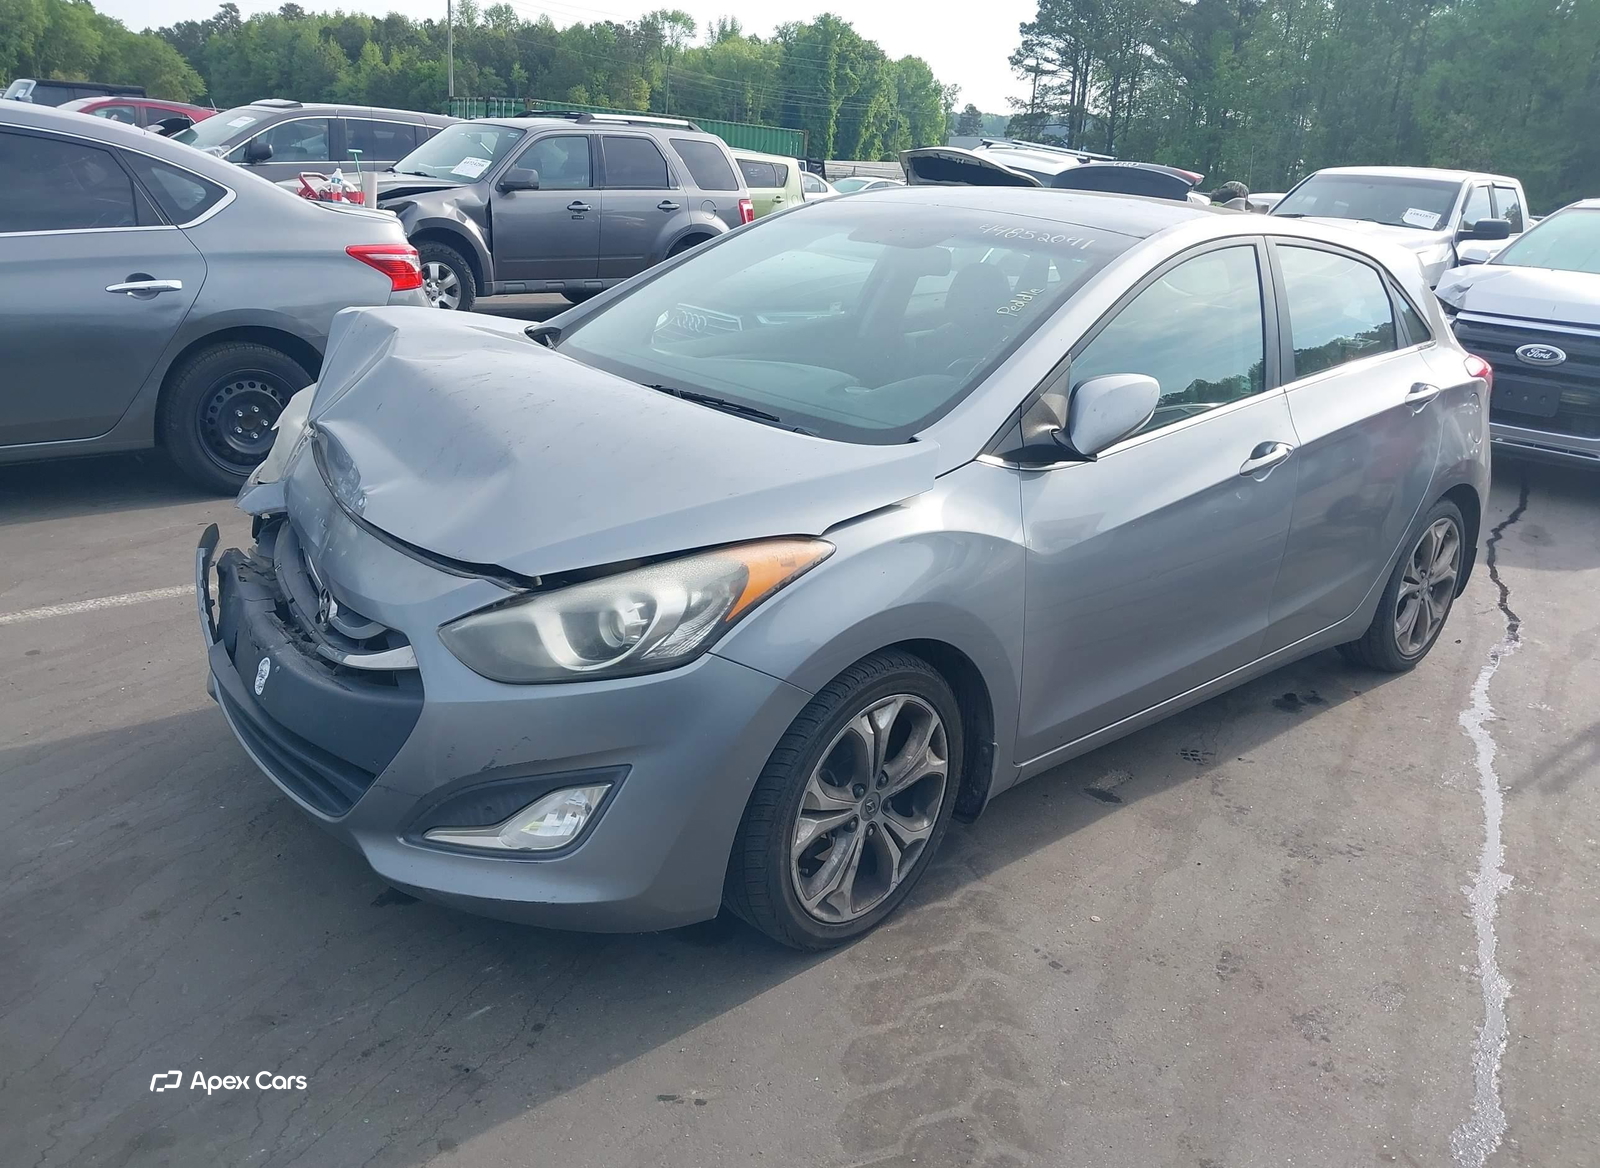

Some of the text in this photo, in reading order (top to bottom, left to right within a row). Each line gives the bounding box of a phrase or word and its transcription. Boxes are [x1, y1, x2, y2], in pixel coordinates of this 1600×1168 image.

[979, 223, 1096, 250] 44852041
[996, 287, 1046, 317] Peddle
[1526, 347, 1553, 359] Ford
